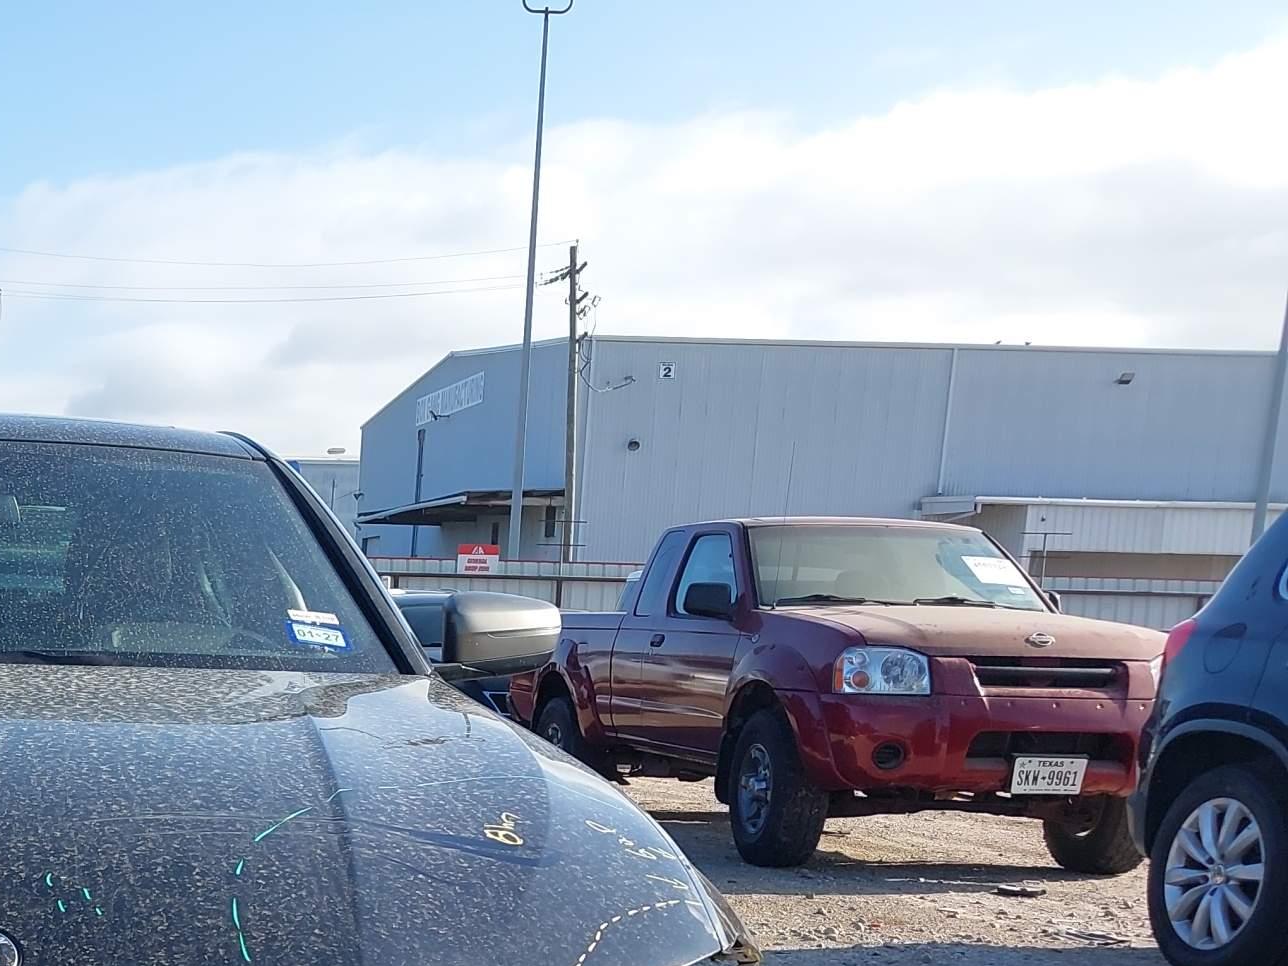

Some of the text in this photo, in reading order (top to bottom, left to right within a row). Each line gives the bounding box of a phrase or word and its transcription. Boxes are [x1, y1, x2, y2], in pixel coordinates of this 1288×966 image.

[662, 366, 672, 378] 2
[296, 628, 340, 643] 01-27
[1038, 760, 1065, 768] TEXAS
